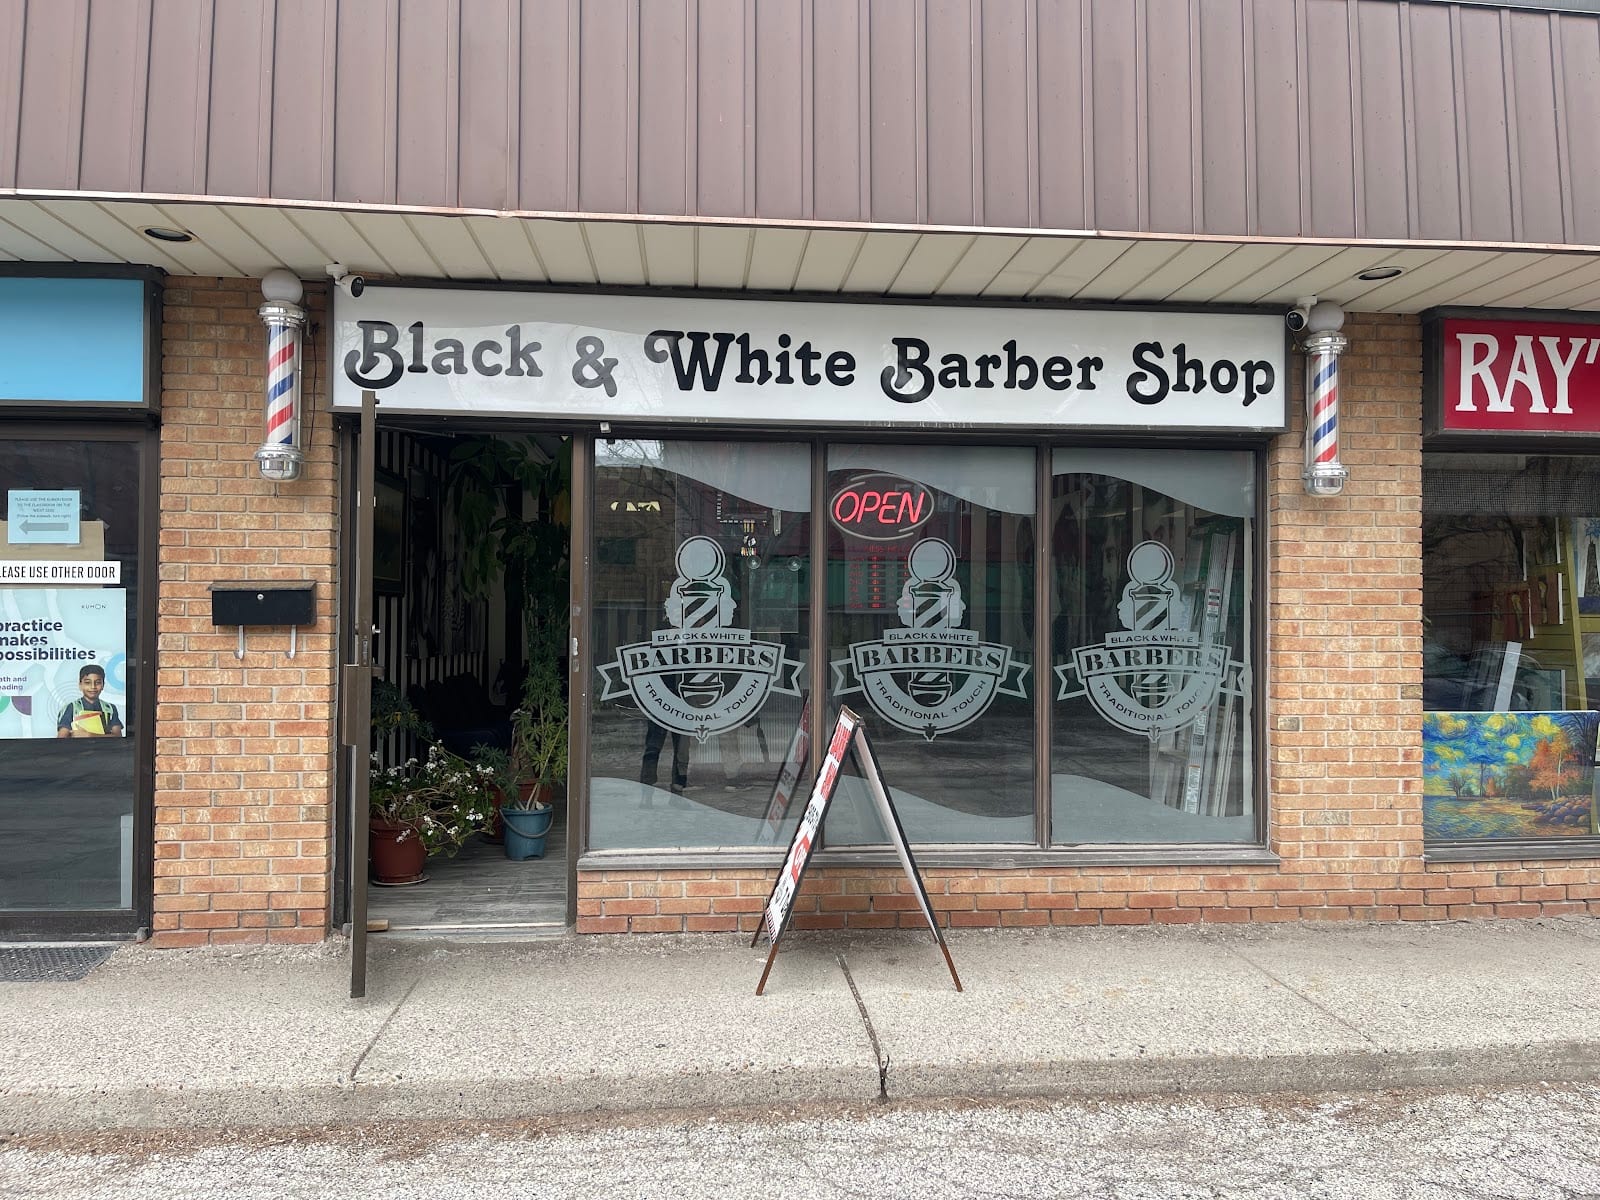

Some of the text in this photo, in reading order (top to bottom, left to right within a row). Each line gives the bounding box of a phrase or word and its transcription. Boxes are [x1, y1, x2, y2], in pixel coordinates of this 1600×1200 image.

[344, 320, 1275, 407] Black & White Barber Shop
[835, 491, 925, 524] OPEN
[0, 566, 115, 578] EASE USE OTHER DOOR
[657, 632, 699, 642] BLACK
[709, 632, 746, 641] WHITE
[889, 632, 930, 641] BLACK
[939, 633, 973, 642] WHITE
[1111, 635, 1150, 643] BLACK
[1160, 635, 1194, 643] WHTE
[628, 647, 775, 671] BARBERS
[862, 647, 1001, 670] BARBERS
[1084, 649, 1221, 672] BARBERS
[645, 679, 759, 721] TRADITIONAL TOUCH
[876, 679, 986, 720] TRADITIONAL TOUCH
[1099, 681, 1207, 721] TRADITIONAL TOUC
